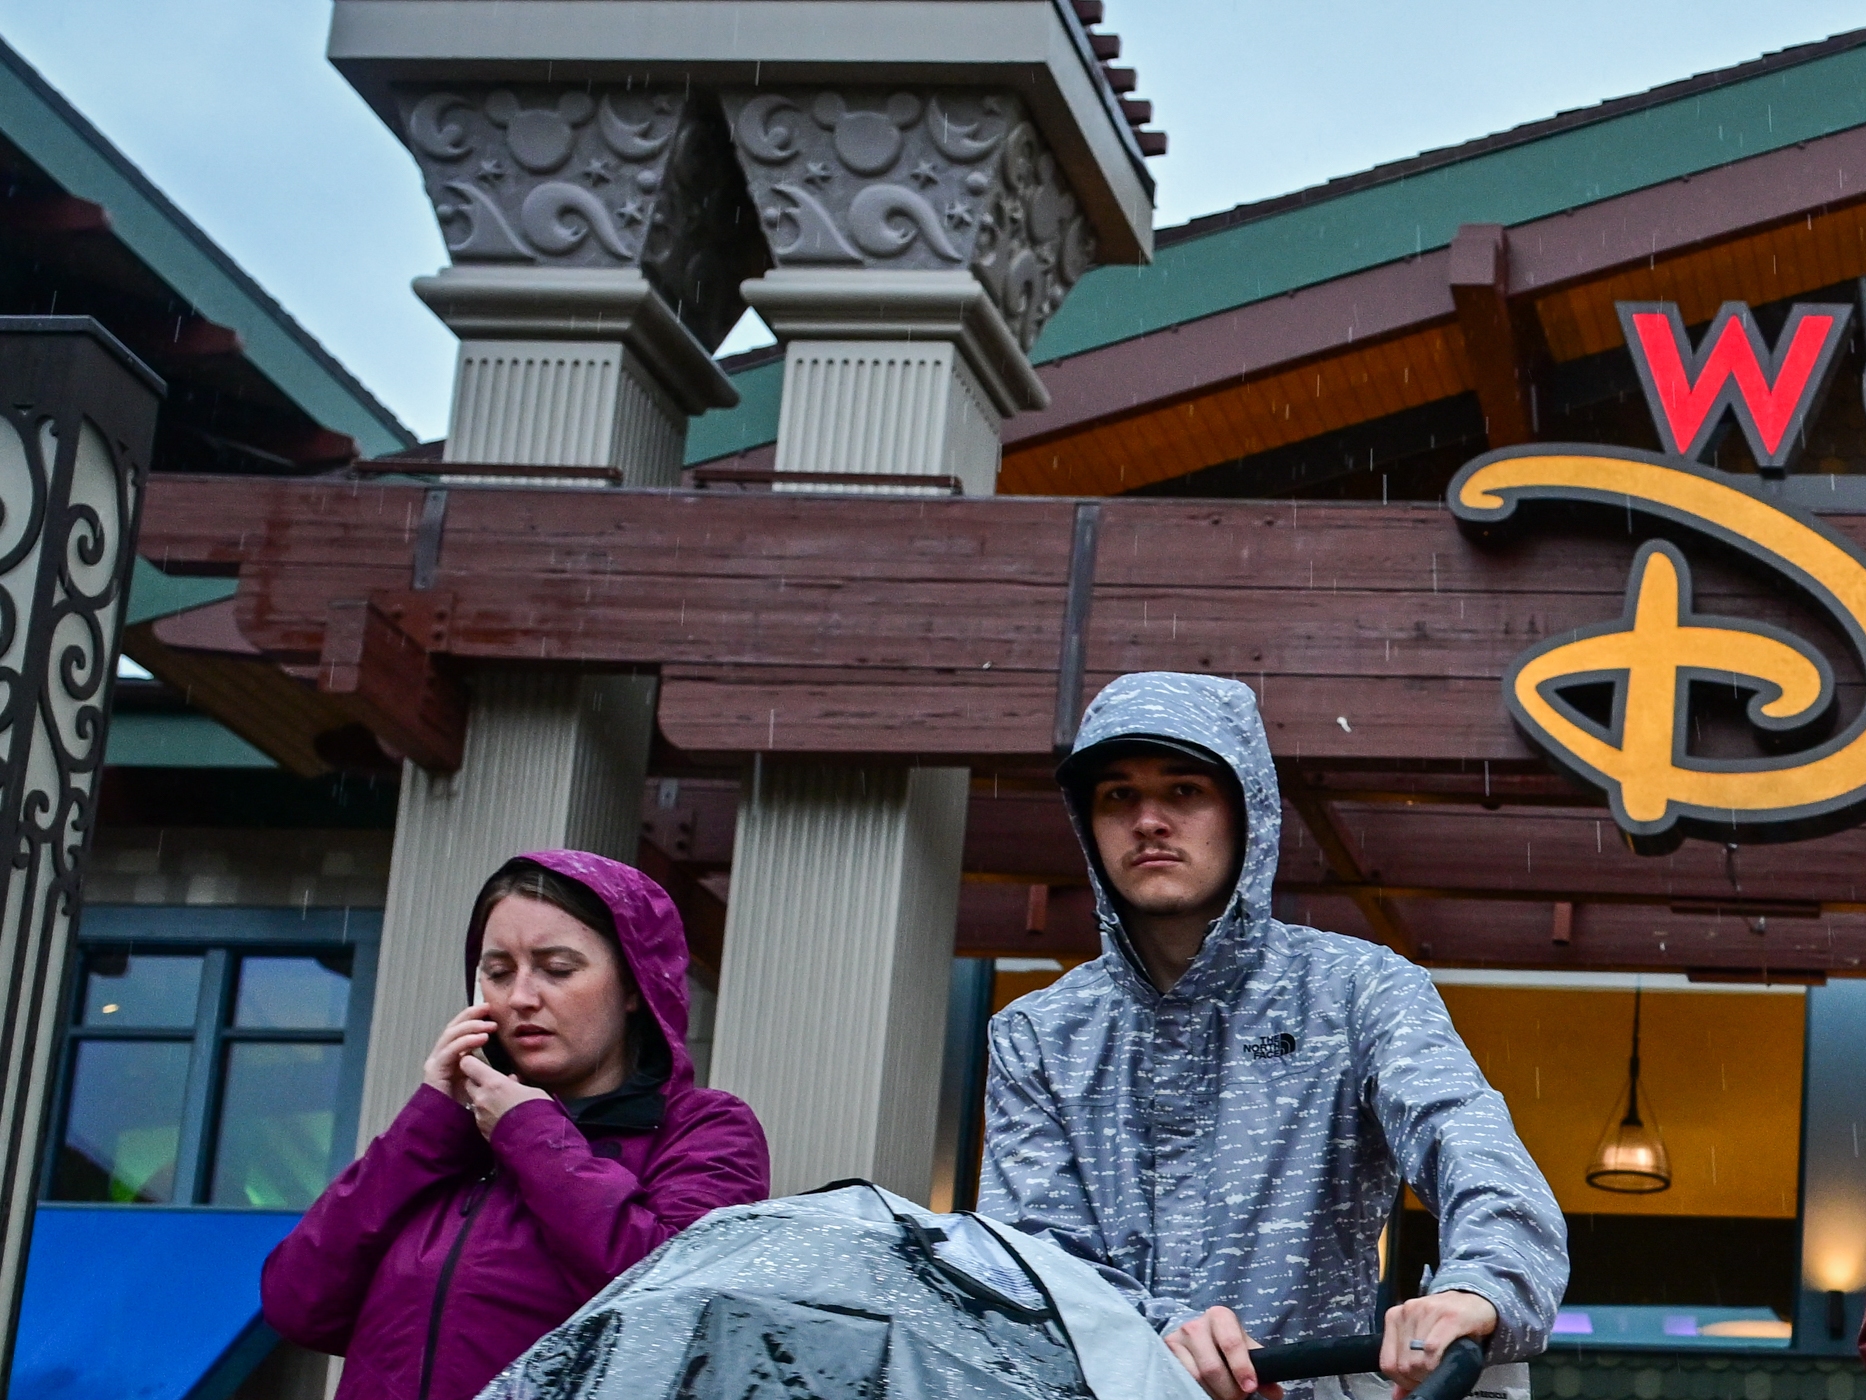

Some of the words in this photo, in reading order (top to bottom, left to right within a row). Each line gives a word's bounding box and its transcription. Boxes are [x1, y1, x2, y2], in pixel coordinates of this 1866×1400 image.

[1259, 1034, 1280, 1045] THE
[1243, 1043, 1280, 1053] NORTH
[1253, 1050, 1281, 1060] FACE
